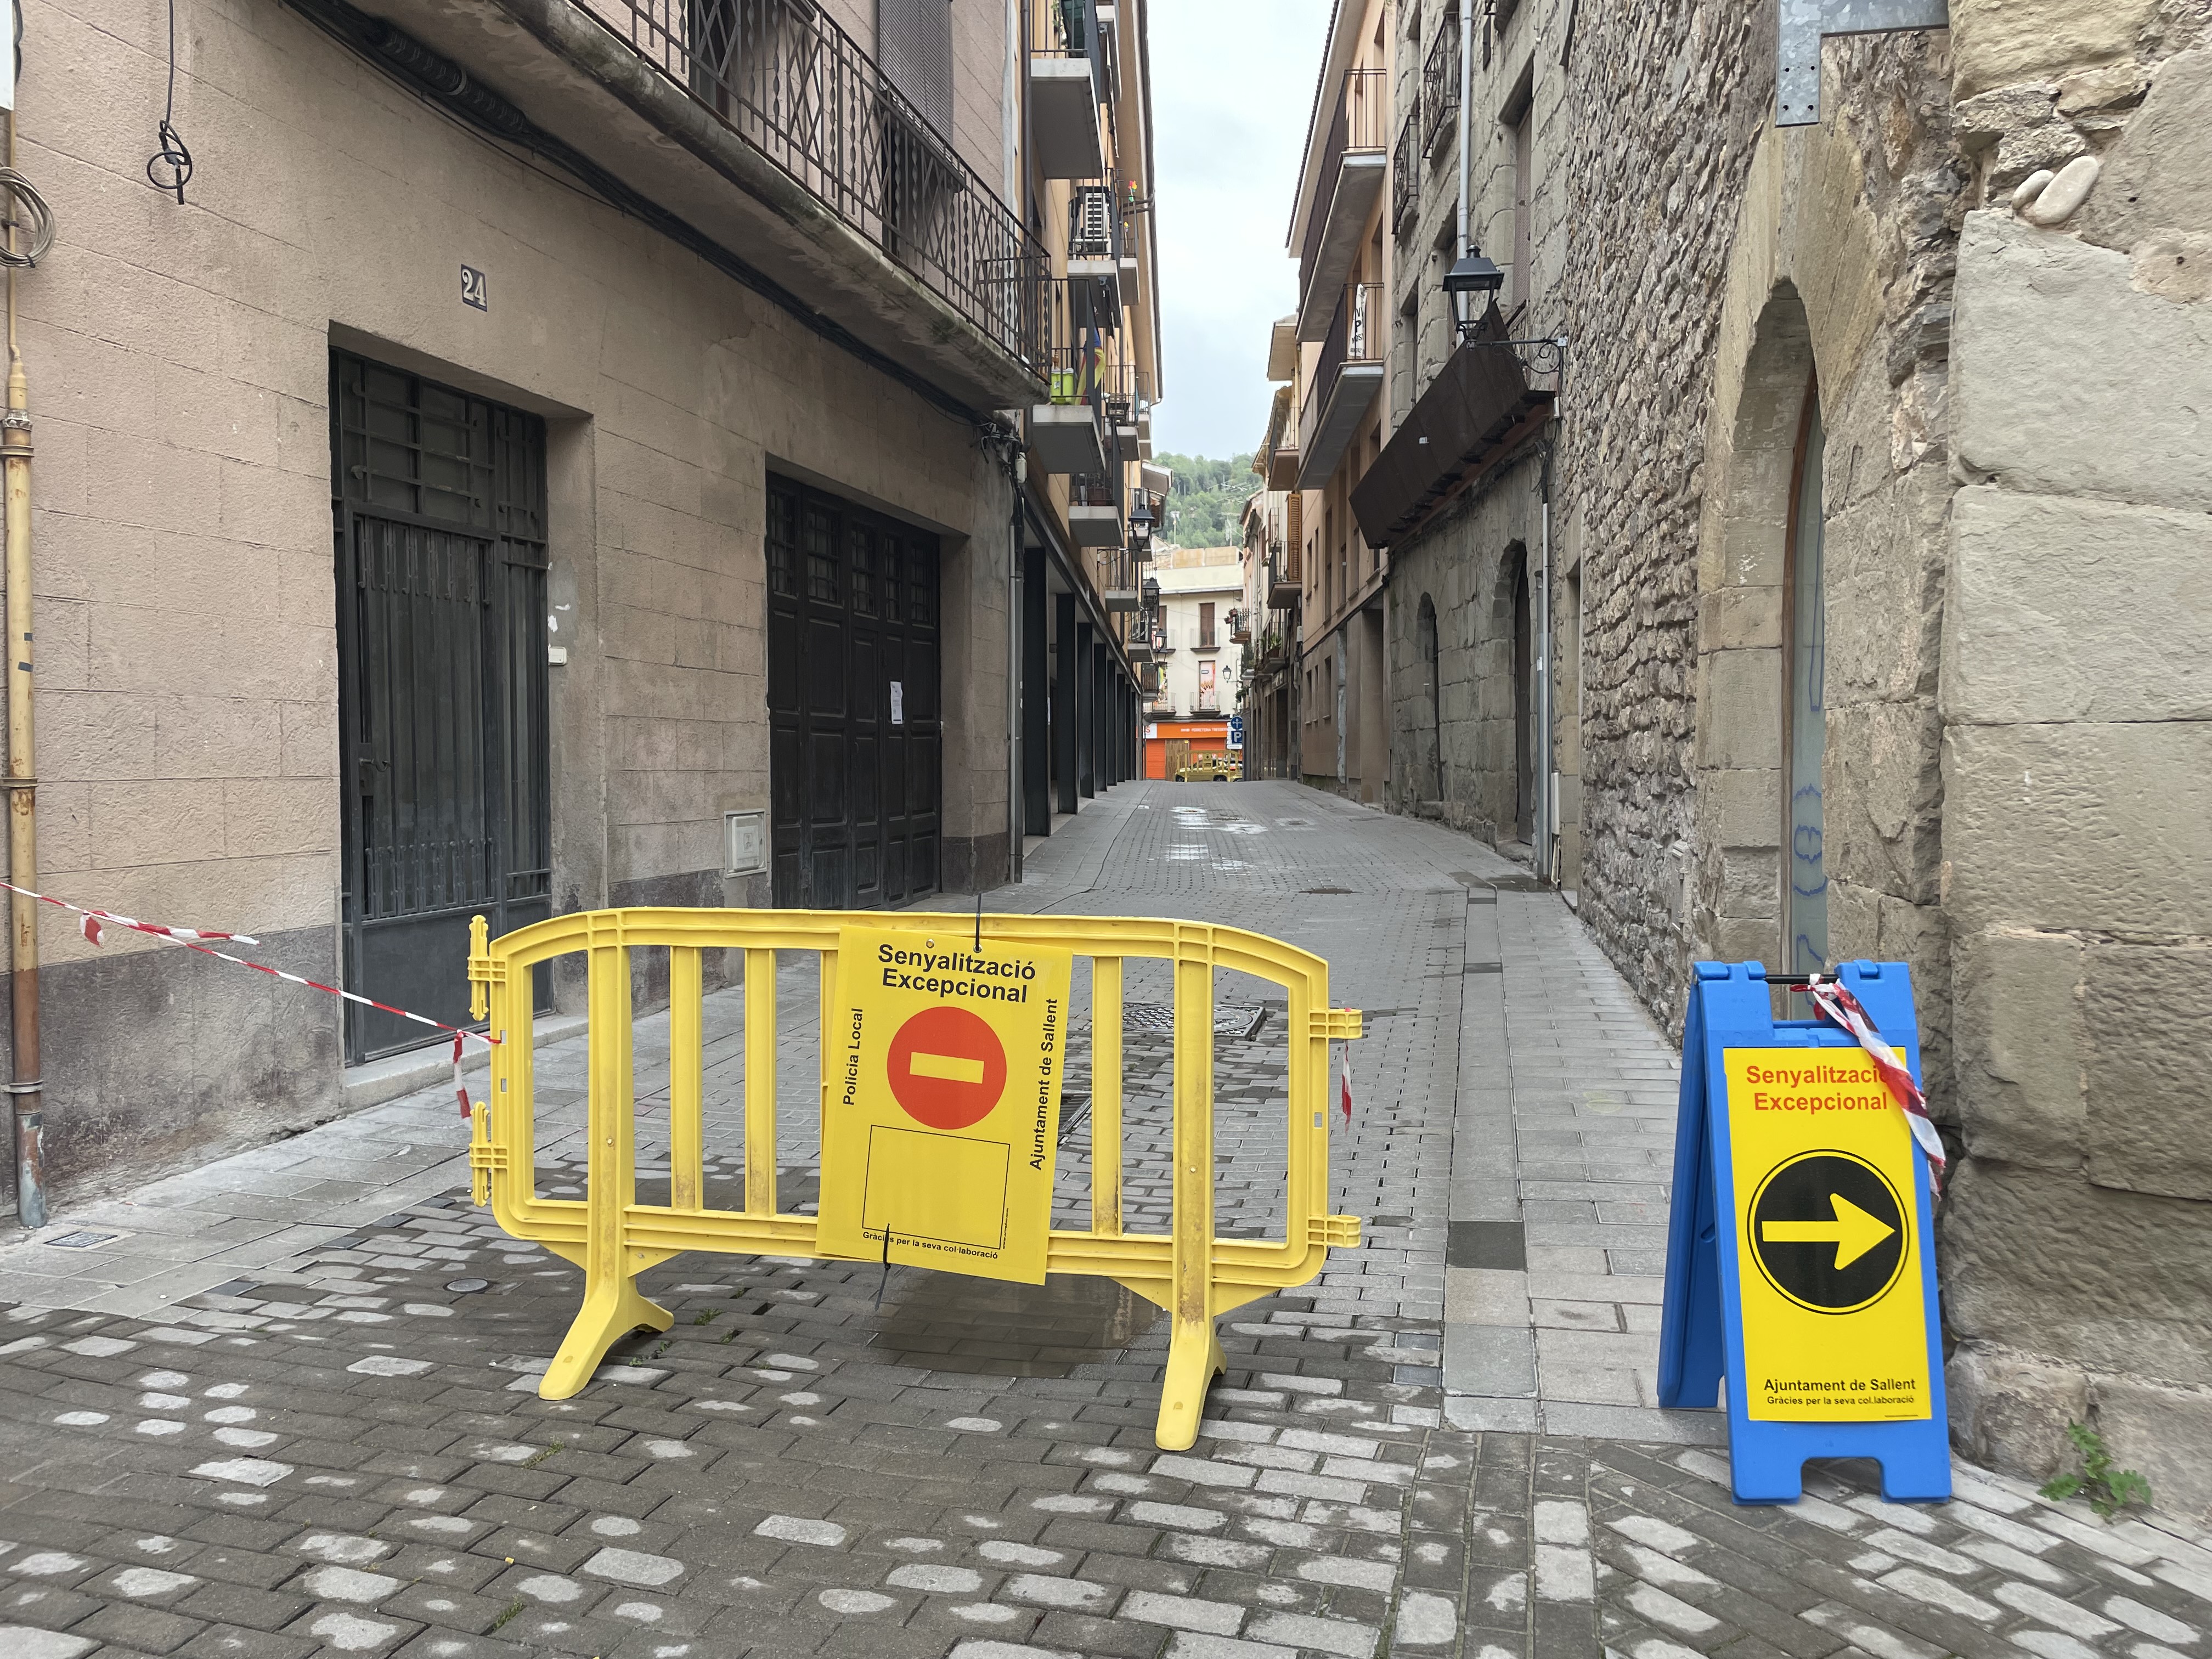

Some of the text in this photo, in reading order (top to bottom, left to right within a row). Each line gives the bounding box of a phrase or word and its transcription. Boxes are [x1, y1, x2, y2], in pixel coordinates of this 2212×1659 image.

[462, 268, 486, 307] 24
[1234, 731, 1242, 742] P
[878, 944, 1036, 980] Senyalització
[882, 967, 1028, 1003] Excepcional
[843, 1008, 863, 1105] Policia Local
[1029, 998, 1058, 1171] Ajuntament de Sallent
[1754, 1092, 1887, 1115] Excepcional
[862, 1231, 894, 1243] Gràcis
[896, 1238, 910, 1246] per
[922, 1242, 941, 1250] seva
[944, 1245, 998, 1259] col·laboració
[1764, 1378, 1916, 1393] Ajuntament de Sallent
[1767, 1396, 1803, 1405] Gràcies
[1805, 1397, 1821, 1406] per
[1824, 1396, 1831, 1404] la
